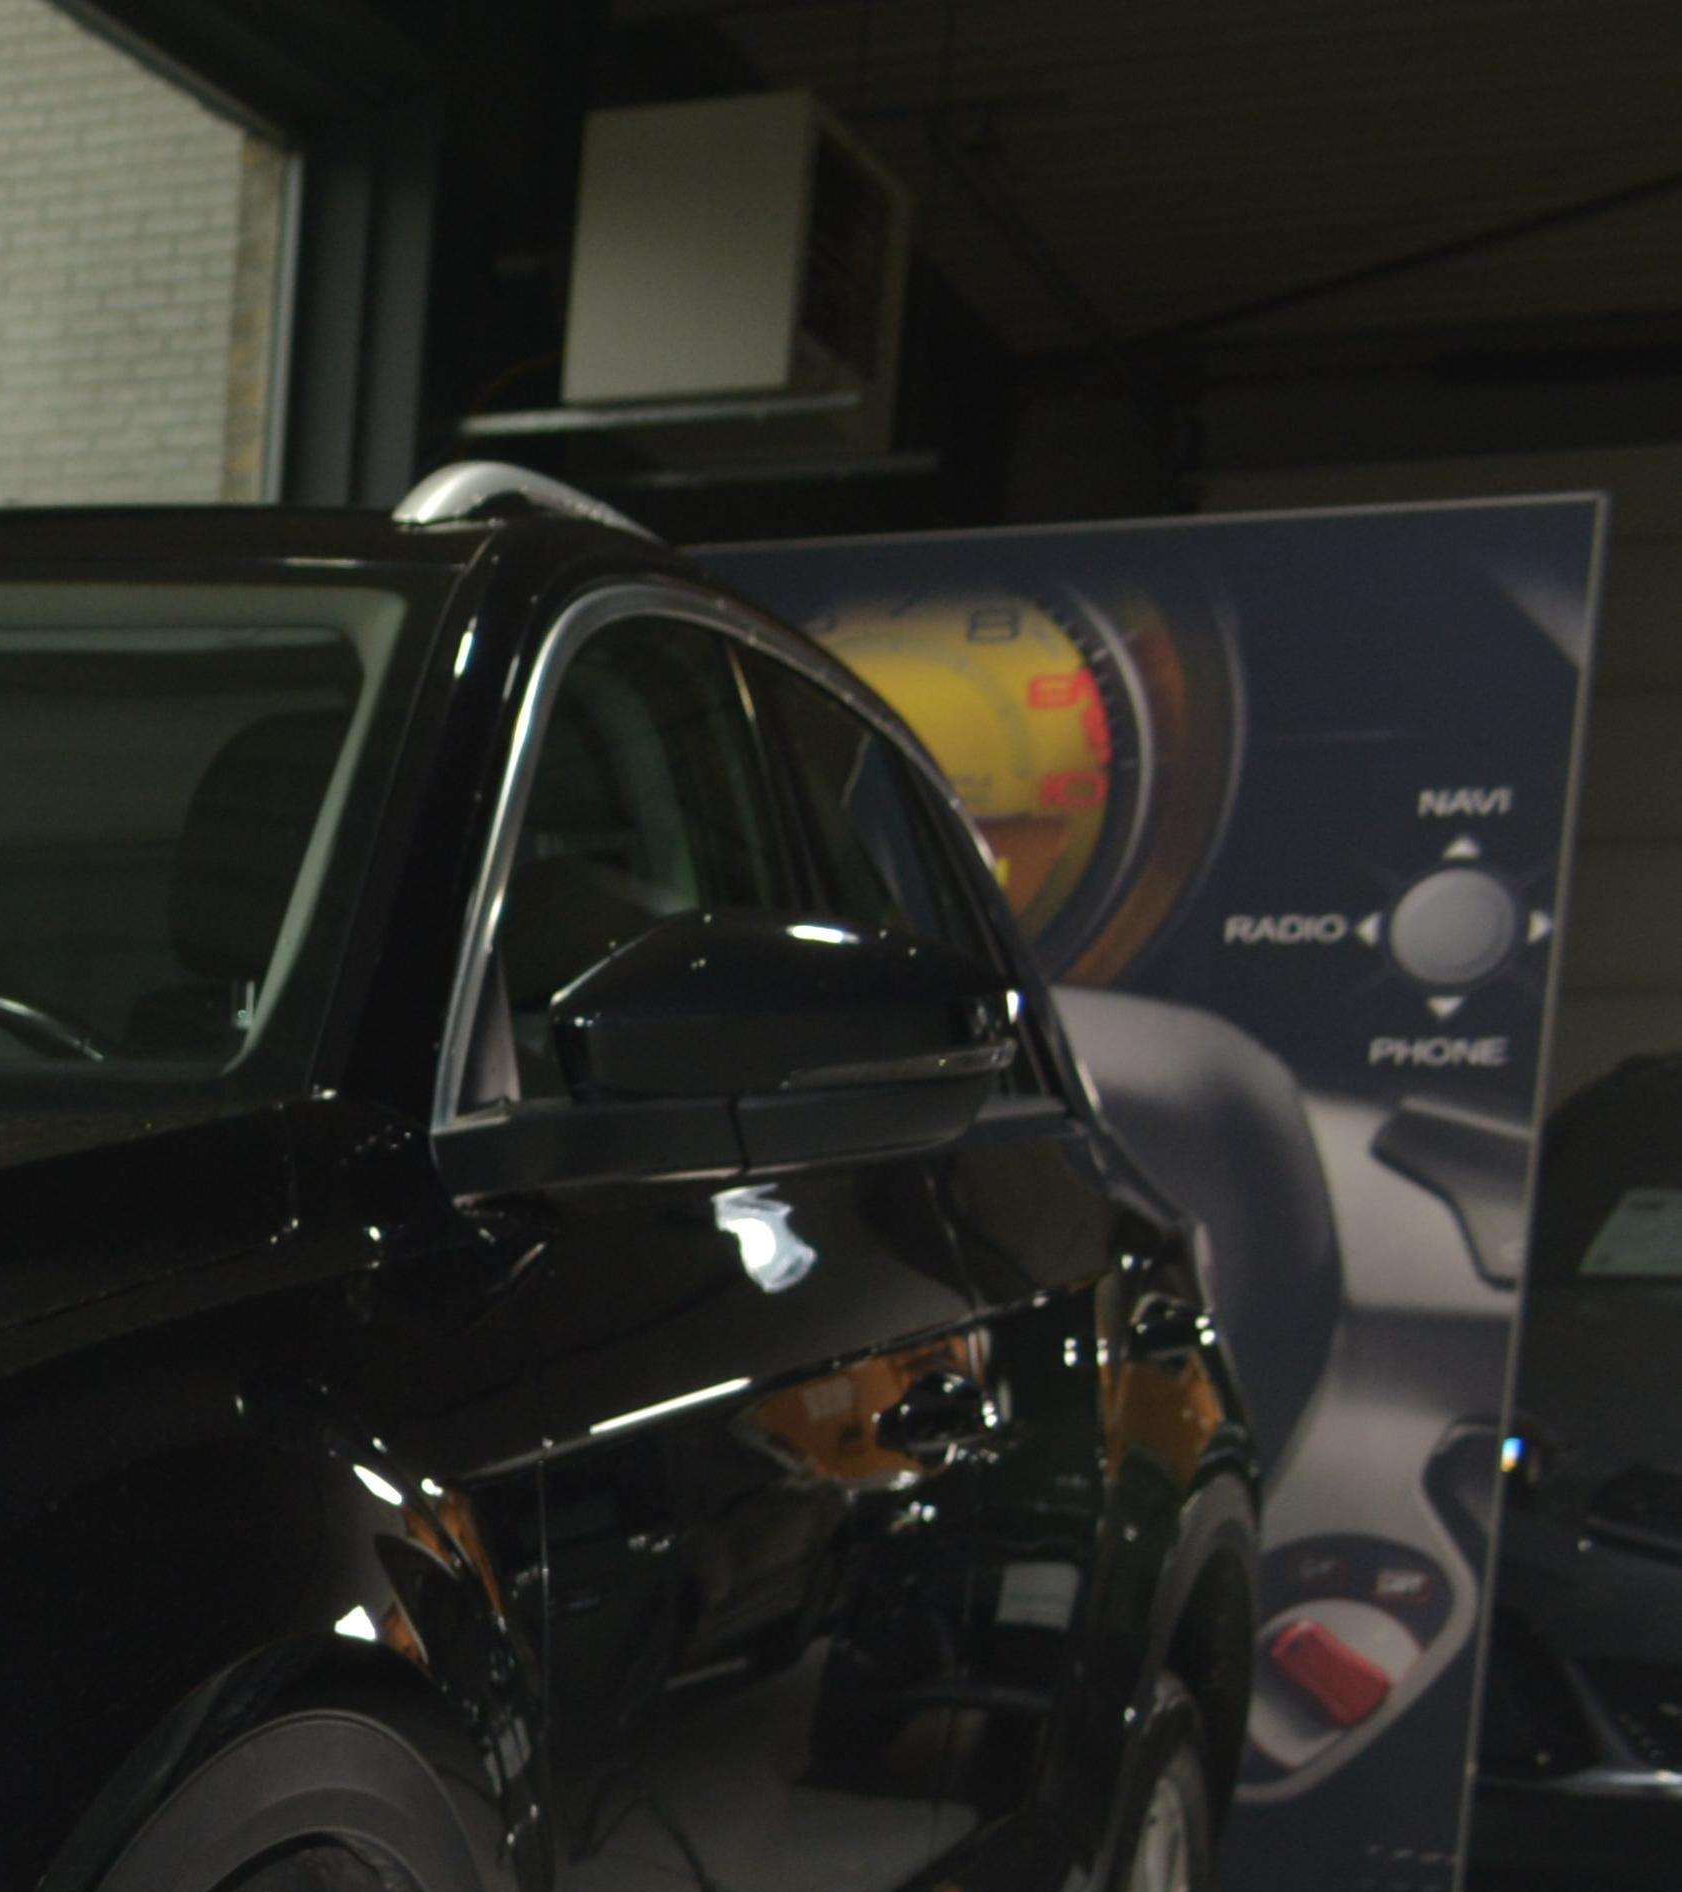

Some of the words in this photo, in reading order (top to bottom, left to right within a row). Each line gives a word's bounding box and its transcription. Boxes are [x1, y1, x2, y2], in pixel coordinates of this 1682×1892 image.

[1418, 788, 1513, 817] NAVI
[1224, 913, 1348, 945] RADIO
[1369, 1036, 1509, 1068] PHONE
